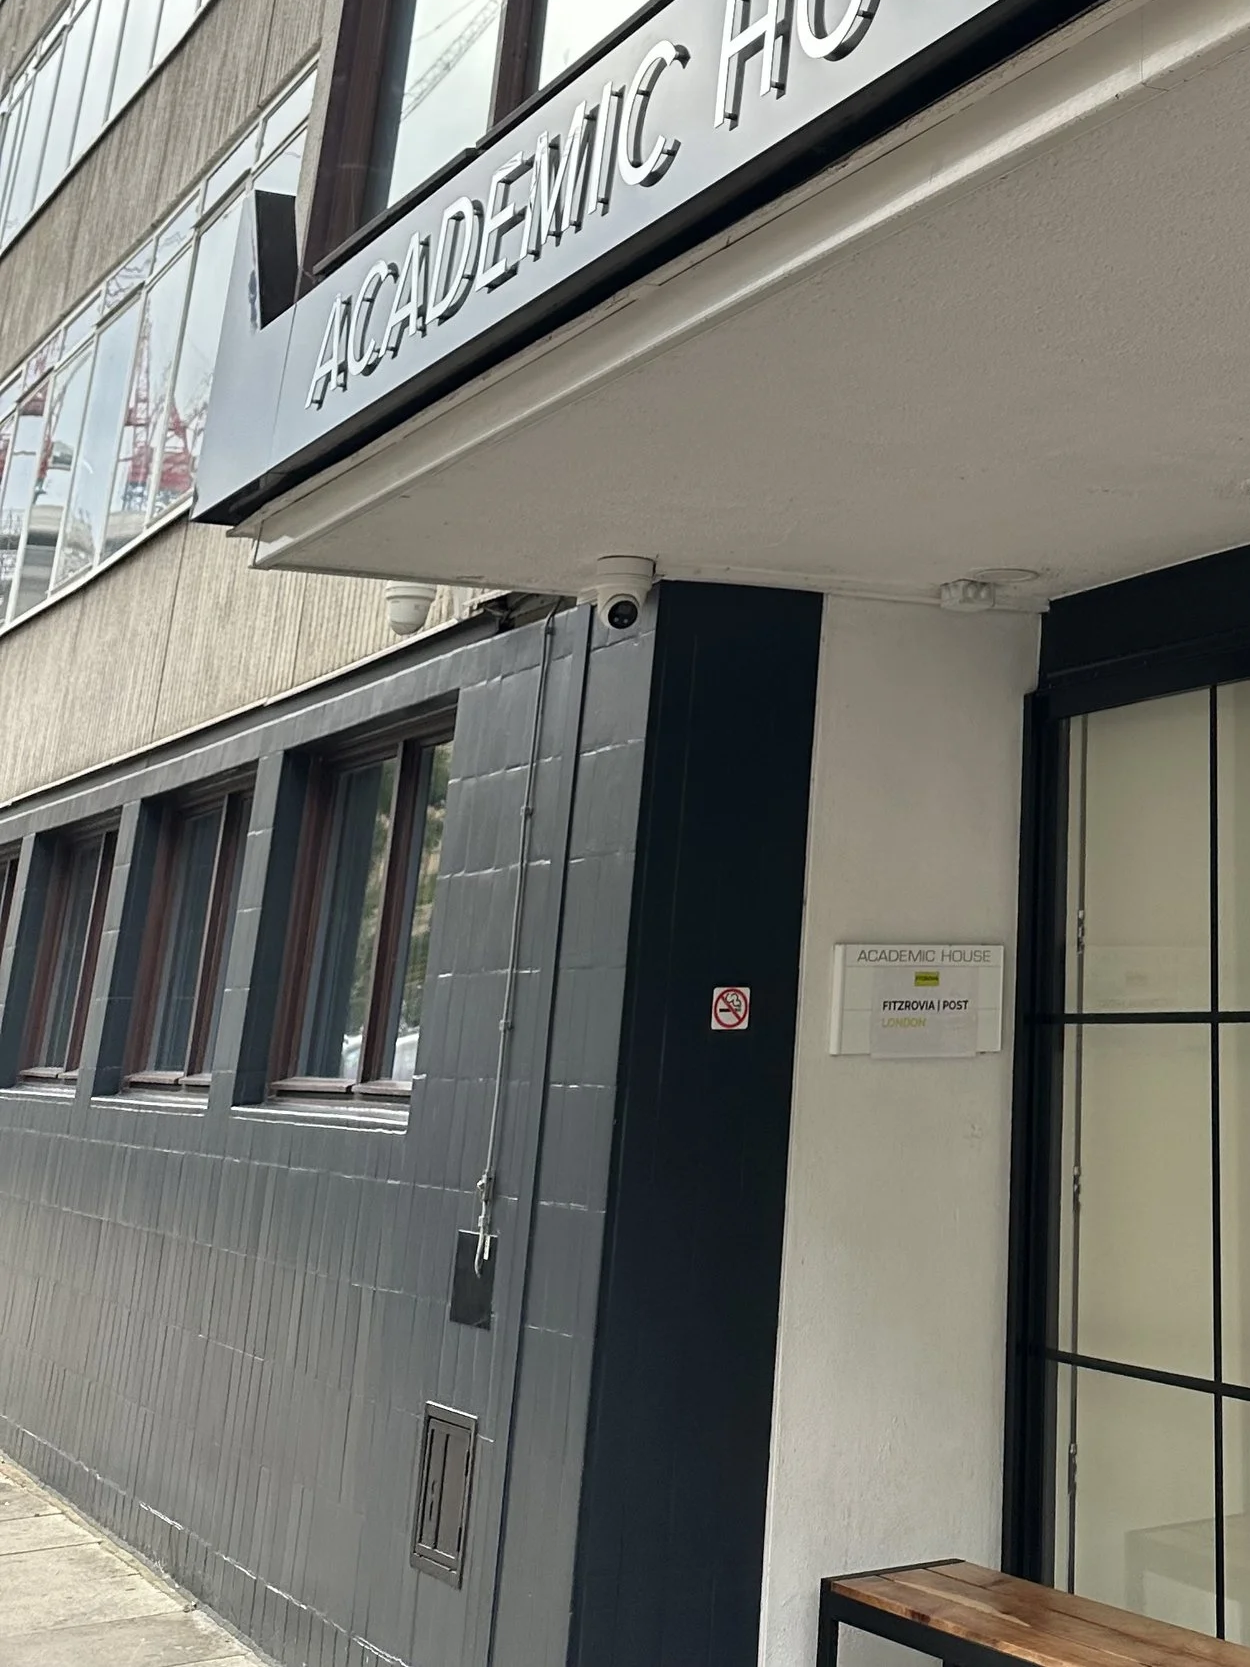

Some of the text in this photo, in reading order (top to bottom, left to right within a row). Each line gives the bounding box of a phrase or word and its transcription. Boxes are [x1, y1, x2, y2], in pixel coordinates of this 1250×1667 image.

[304, 40, 686, 409] ACADEMIC
[857, 949, 991, 963] ACADEMIC HOUSE
[882, 1000, 935, 1011] FITZROVIA
[942, 999, 969, 1011] POST
[882, 1017, 927, 1028] LONDON
